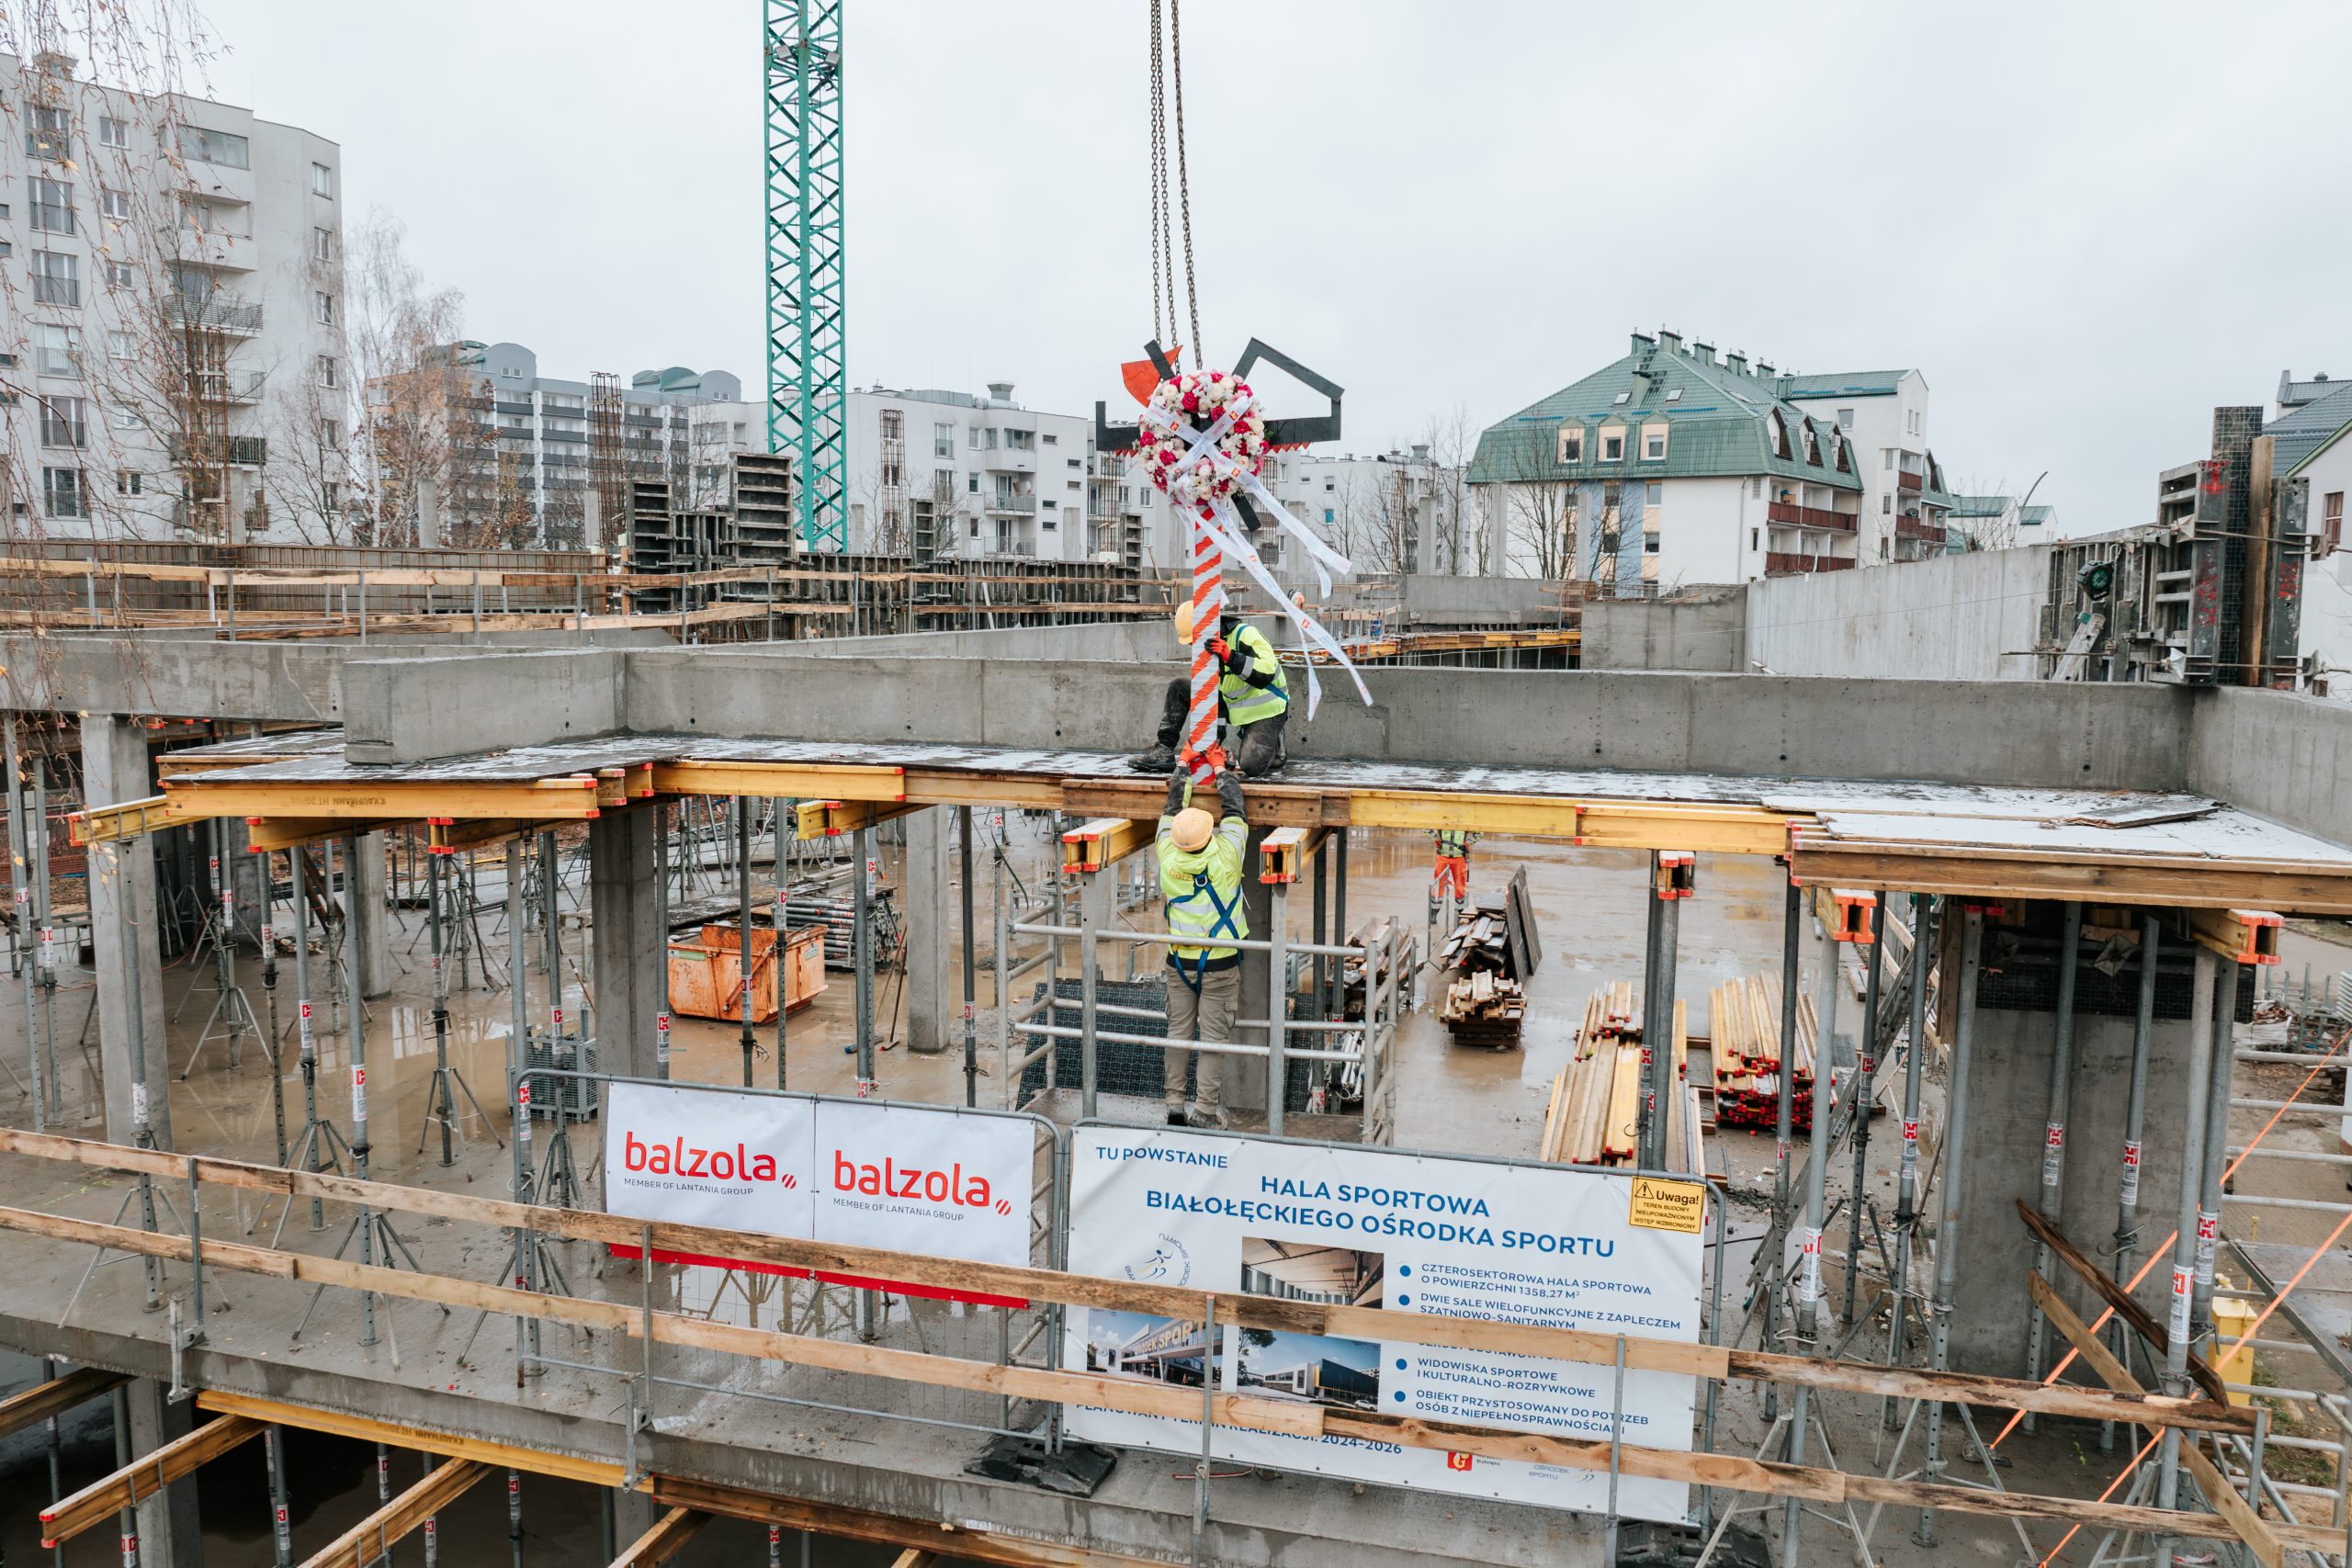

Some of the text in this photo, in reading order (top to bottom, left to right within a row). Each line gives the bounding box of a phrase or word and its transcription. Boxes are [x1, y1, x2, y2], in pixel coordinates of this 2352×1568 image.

[625, 1131, 776, 1181] balzola
[1096, 1146, 1228, 1168] TU POWSTANIE
[624, 1178, 662, 1189] MEMBER
[662, 1182, 674, 1190] OF
[676, 1183, 719, 1194] LANTANIA
[834, 1149, 990, 1208] balzola
[833, 1197, 964, 1222] MEMBER OF LANTANIA GROUP
[1261, 1176, 1490, 1218] HALA SPORTOWA
[1643, 1201, 1690, 1213] TEREN BUDOWY
[1656, 1190, 1699, 1205] Uwaga!
[1147, 1190, 1614, 1258] BIAŁOŁĘCKIEGO OŚRODKA SPORTU
[1656, 1220, 1696, 1229] WZBRONIONY
[1421, 1263, 1652, 1295] CZTEROSEKTOROWA HALA SPORTOWA
[1421, 1275, 1430, 1283] O
[1432, 1276, 1516, 1293] POWIERZCHNI
[1520, 1286, 1563, 1299] 1358,27
[1420, 1292, 1680, 1329] DWIE SALE WIELOFUNKCYJNE Z ZAPLECZEM
[1420, 1304, 1576, 1329] SZATNIOWO-SANITARNYM
[1418, 1358, 1558, 1381] WIDOWISKA SPORTOWE
[1422, 1370, 1596, 1398] KULTURALNO-ROZRYWKOWE
[1417, 1390, 1460, 1403] OBIEKT
[1462, 1395, 1569, 1416] PRZYSTOSOWANY
[1571, 1407, 1589, 1417] DO
[1416, 1402, 1625, 1435] OSÓB Z NIEPEŁNOSPRAWNOŚCIAI
[1321, 1433, 1402, 1454] 2024-2026
